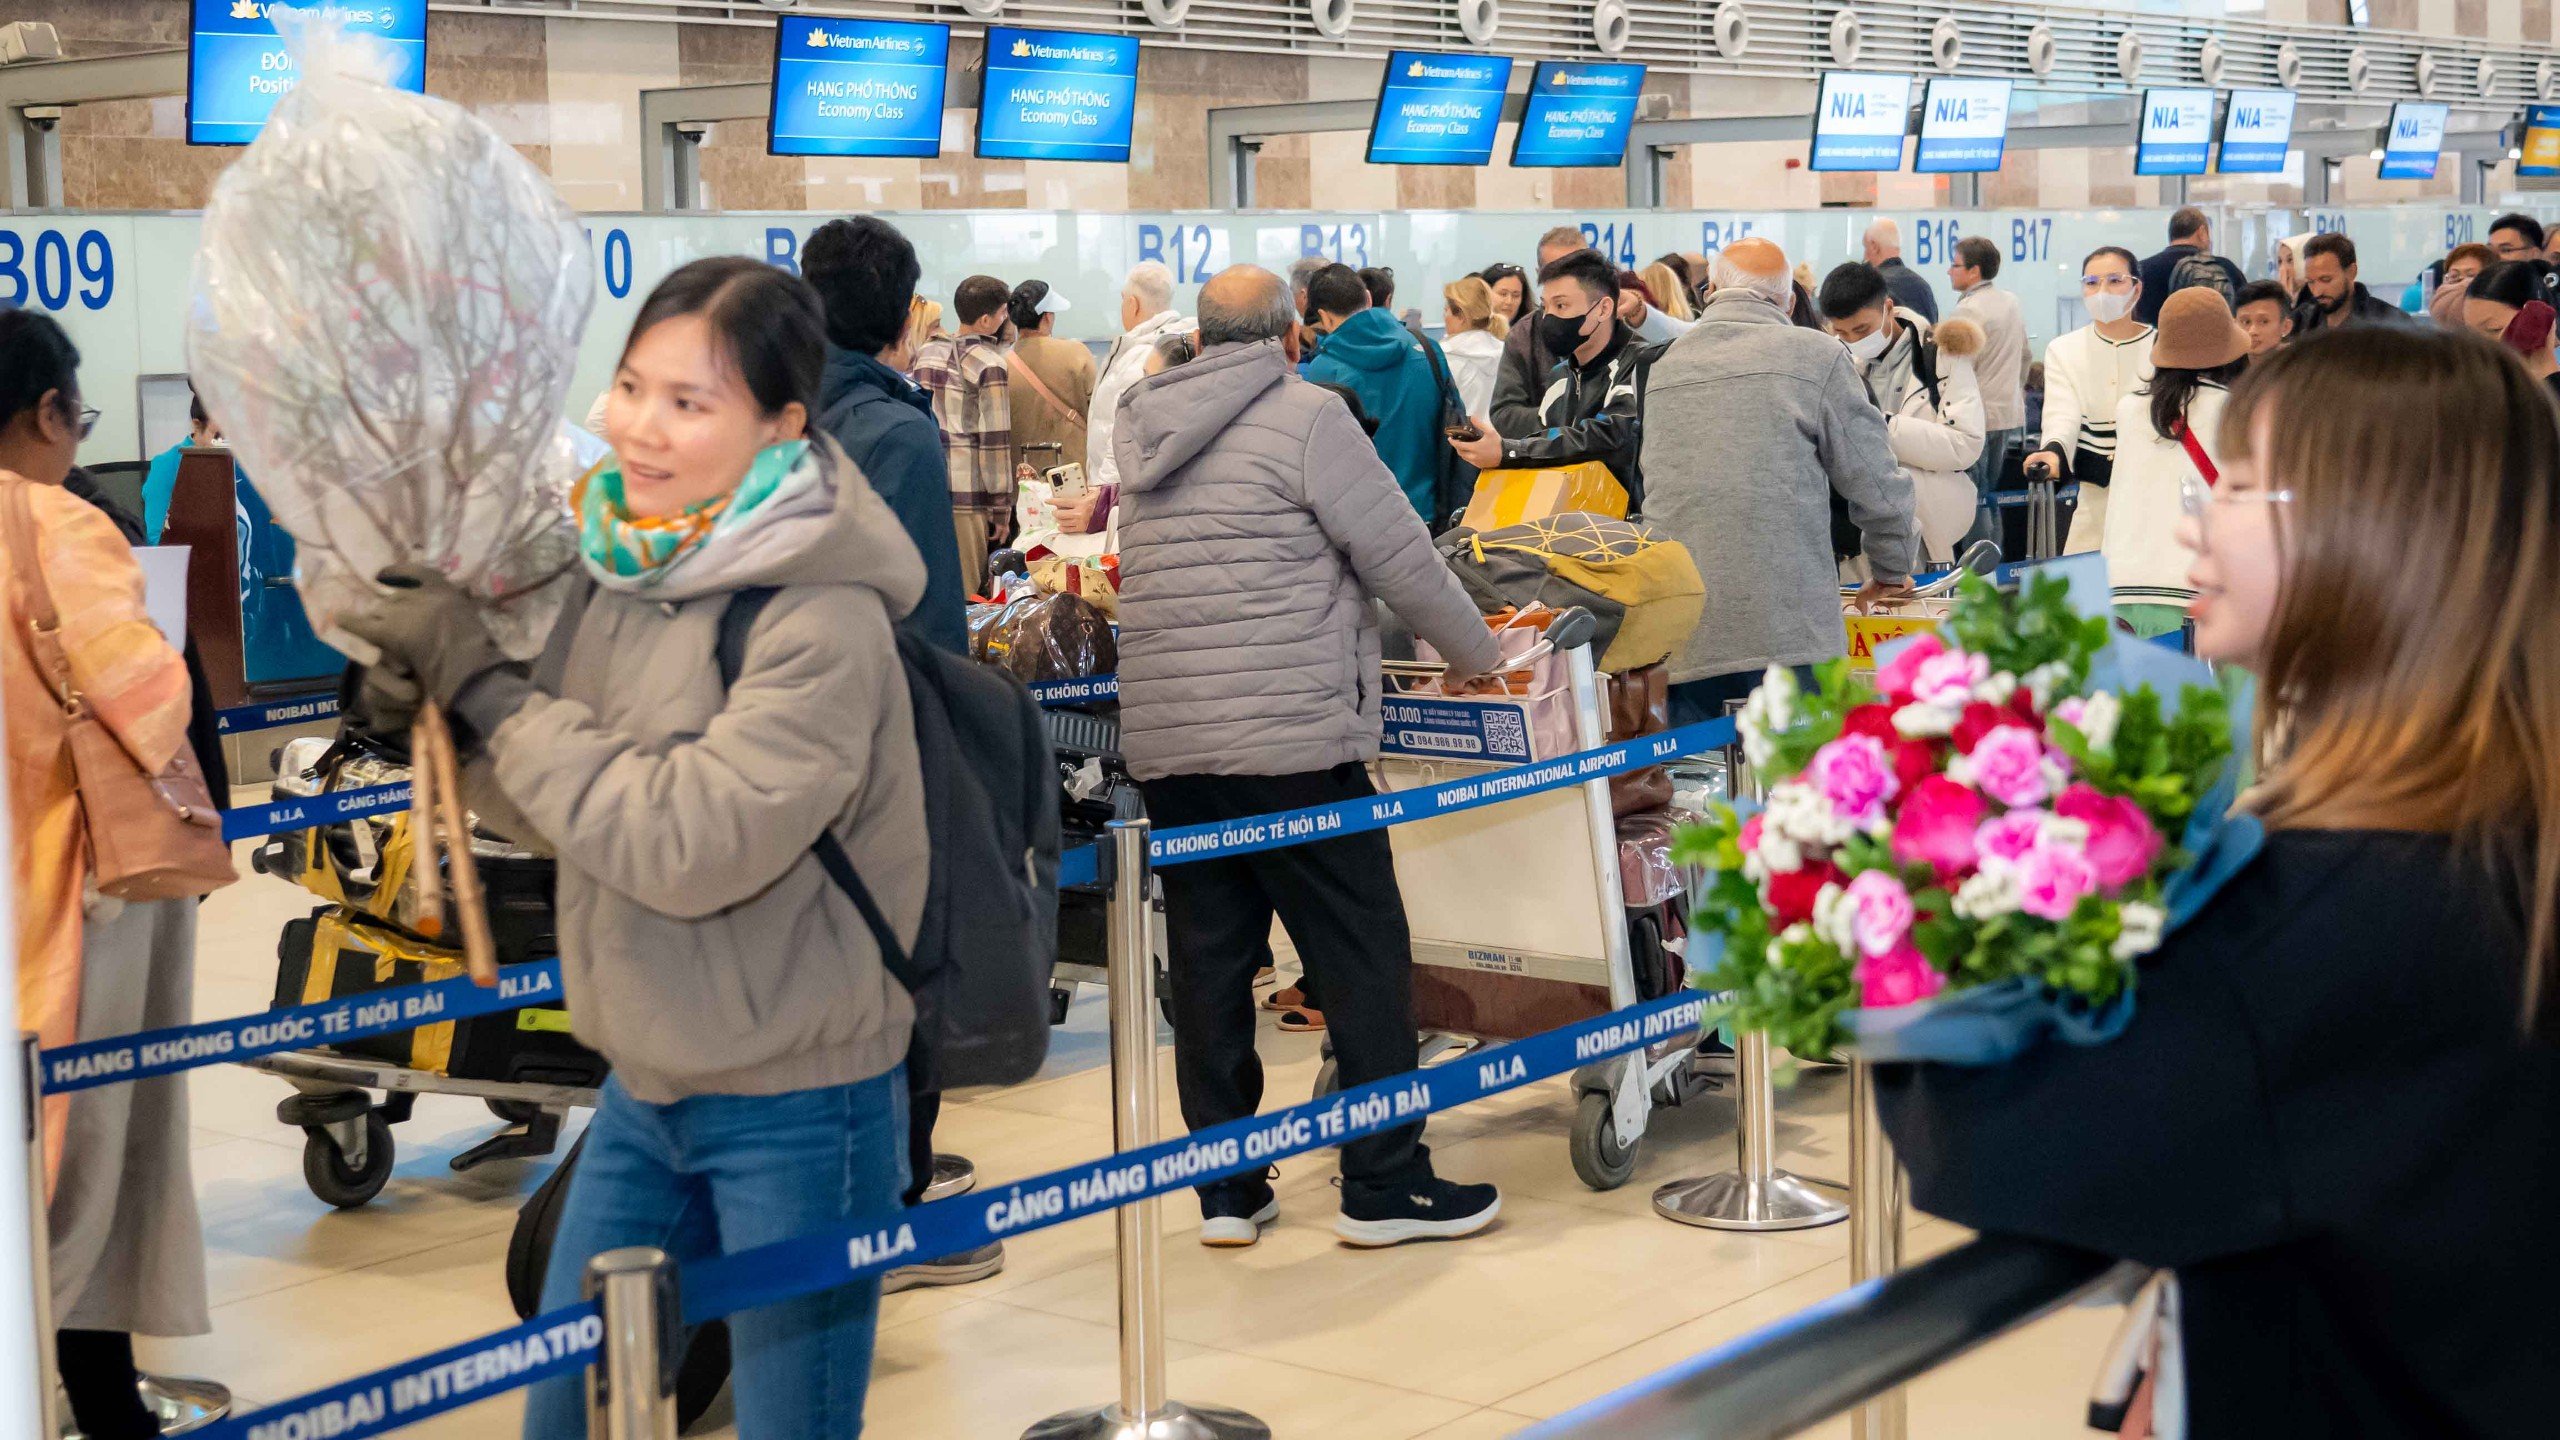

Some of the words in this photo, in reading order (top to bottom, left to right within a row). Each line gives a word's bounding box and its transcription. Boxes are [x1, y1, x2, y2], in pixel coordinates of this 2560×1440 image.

[829, 33, 872, 49] Vietnam
[873, 36, 911, 52] Airlines
[1030, 44, 1070, 59] Vietnam
[1070, 47, 1104, 62] Airlines
[250, 76, 293, 95] Positi
[818, 100, 872, 121] Economy
[874, 102, 904, 119] Class
[1831, 92, 1865, 118] NIA
[1935, 98, 1968, 122] NIA
[1020, 107, 1069, 127] Economy
[1072, 110, 1098, 126] Class
[1406, 120, 1446, 137] Economy
[1447, 121, 1469, 135] Class
[2152, 106, 2179, 129] NIA
[2235, 107, 2261, 129] NIA
[1585, 125, 1606, 139] Class
[2396, 119, 2419, 139] NIA
[1702, 221, 1752, 259] B1
[1917, 219, 1960, 265] B16
[2012, 218, 2052, 262] B17
[2445, 213, 2473, 249] B20
[1138, 223, 1213, 284] B12
[1301, 223, 1368, 269] B13
[0, 229, 114, 310] B09
[1046, 682, 1090, 700] KHÔNG
[1093, 674, 1120, 695] QUỐ
[266, 704, 315, 722] NOIBAI
[1382, 705, 1422, 724] 20.000
[1166, 831, 1219, 855] KHÔNG
[1288, 814, 1314, 839] NỘI
[1317, 809, 1342, 831] BÀI
[1372, 801, 1404, 820] N.I.A
[1436, 785, 1479, 808] NOIBAI
[1481, 763, 1576, 798] INTERNATIONAL
[1579, 749, 1628, 775] AIRPORT
[1652, 737, 1678, 758] N.I.A
[269, 807, 304, 824] N.I.A
[1468, 950, 1505, 963] BIZMAN
[356, 996, 399, 1031] NỘI
[499, 970, 553, 1000] N.I.A
[847, 1222, 918, 1269] N.I.A
[984, 1184, 1065, 1233] CẢNG
[1069, 1163, 1147, 1209] HÀNG
[1151, 1137, 1240, 1187] KHÔNG
[1244, 1110, 1312, 1158] QUỐC
[1316, 1096, 1346, 1139] TẾ
[1348, 1092, 1391, 1133] NỘI
[1394, 1080, 1432, 1113] BÀI
[1479, 1054, 1528, 1090] N.I.A
[1575, 1018, 1641, 1061] NOIBAI
[1644, 989, 1738, 1039] INTERNAT
[246, 1395, 387, 1440] NOIBAI
[392, 1314, 603, 1414] INTERNATIO
